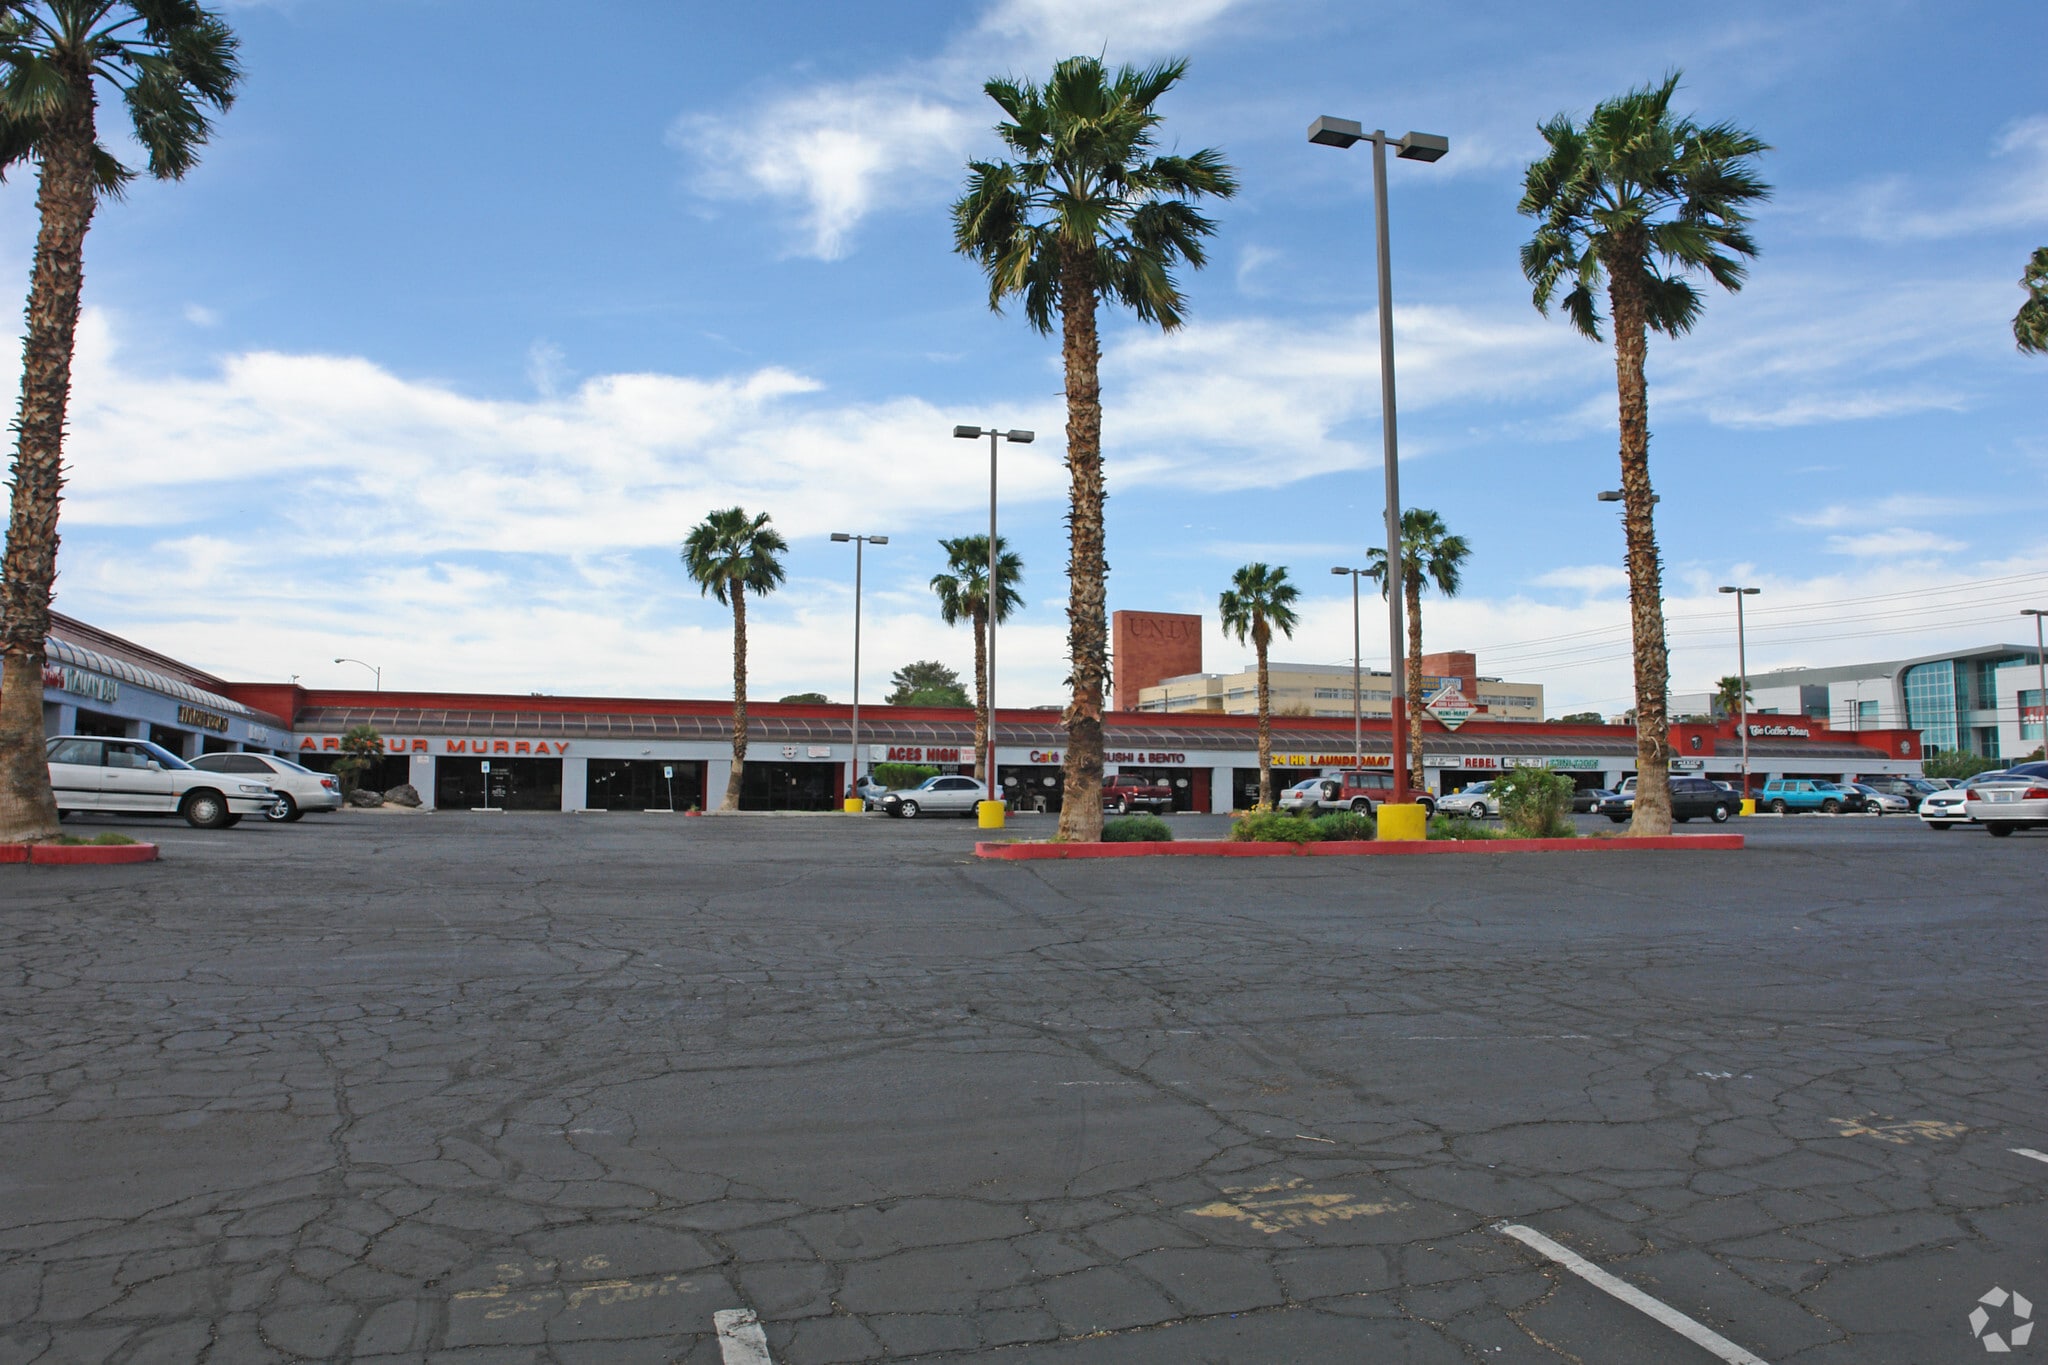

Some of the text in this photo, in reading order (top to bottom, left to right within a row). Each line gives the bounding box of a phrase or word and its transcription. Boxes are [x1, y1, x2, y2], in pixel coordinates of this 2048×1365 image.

[1129, 618, 1194, 639] UNLV
[1764, 725, 1788, 736] Coffee
[1788, 725, 1810, 738] Bean
[446, 739, 569, 755] MURRAY
[888, 746, 959, 763] ACES HIGH
[1030, 751, 1059, 763] Café
[1138, 753, 1146, 763] &
[1149, 753, 1186, 764] BENTO
[1272, 754, 1287, 766] 24
[1289, 754, 1307, 766] HR
[1464, 757, 1497, 768] REBEL
